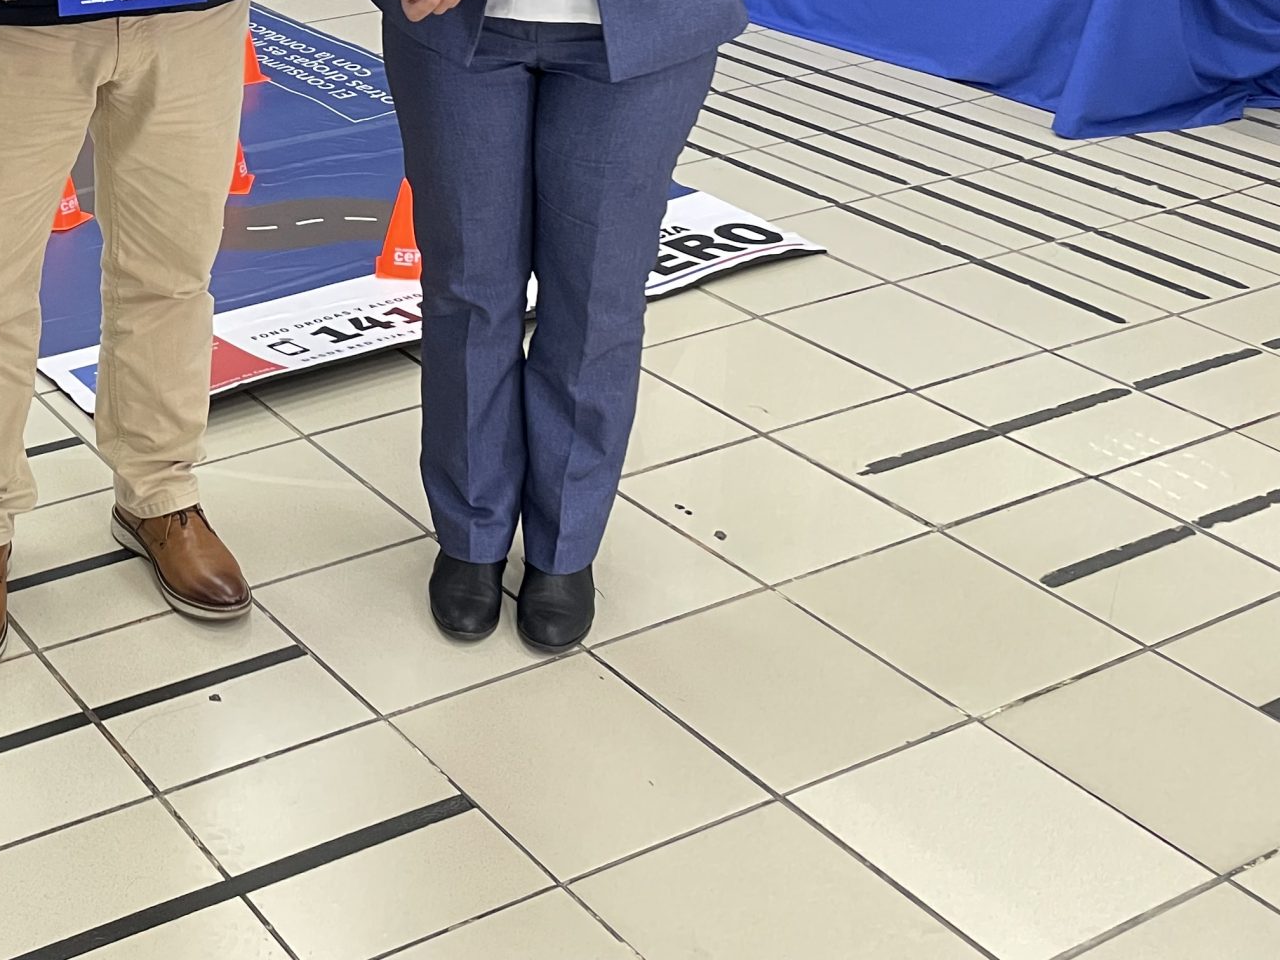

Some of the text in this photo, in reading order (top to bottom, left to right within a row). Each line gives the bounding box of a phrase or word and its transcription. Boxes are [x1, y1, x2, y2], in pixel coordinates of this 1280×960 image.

[263, 45, 287, 56] es
[313, 51, 336, 63] la
[284, 54, 349, 82] drogas
[332, 58, 372, 78] con
[327, 88, 358, 100] El
[250, 327, 290, 341] FONO
[293, 310, 352, 329] DROGAS
[309, 301, 422, 344] 141
